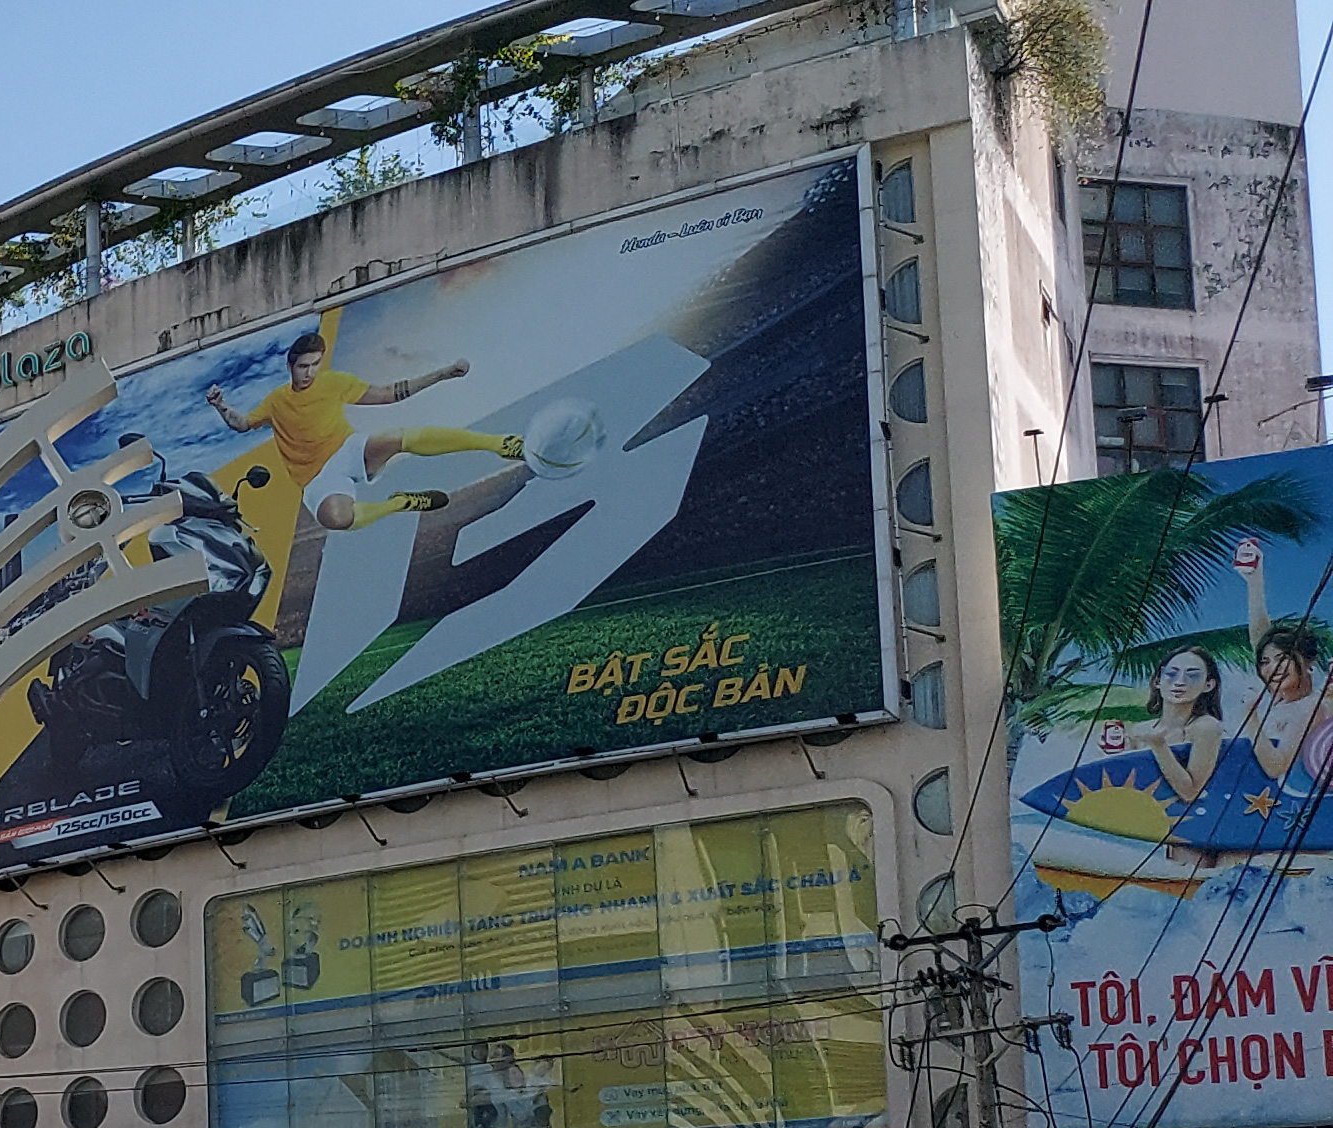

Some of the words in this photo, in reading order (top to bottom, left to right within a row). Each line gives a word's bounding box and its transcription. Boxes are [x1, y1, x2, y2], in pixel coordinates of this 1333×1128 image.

[566, 650, 641, 697] BẬT
[660, 621, 751, 673] SẮC
[615, 683, 706, 727] ĐỘC
[713, 662, 808, 709] BẢN
[55, 807, 153, 837] 125cc/150cc
[519, 858, 568, 879] NAM
[570, 856, 587, 872] A
[590, 845, 651, 870] BANK
[339, 931, 398, 952] DOANH
[1070, 970, 1157, 1027] TÔI,
[1170, 959, 1276, 1022] ĐÀM
[1088, 1032, 1161, 1090] TÔI
[1177, 1031, 1306, 1091] CHỌN
